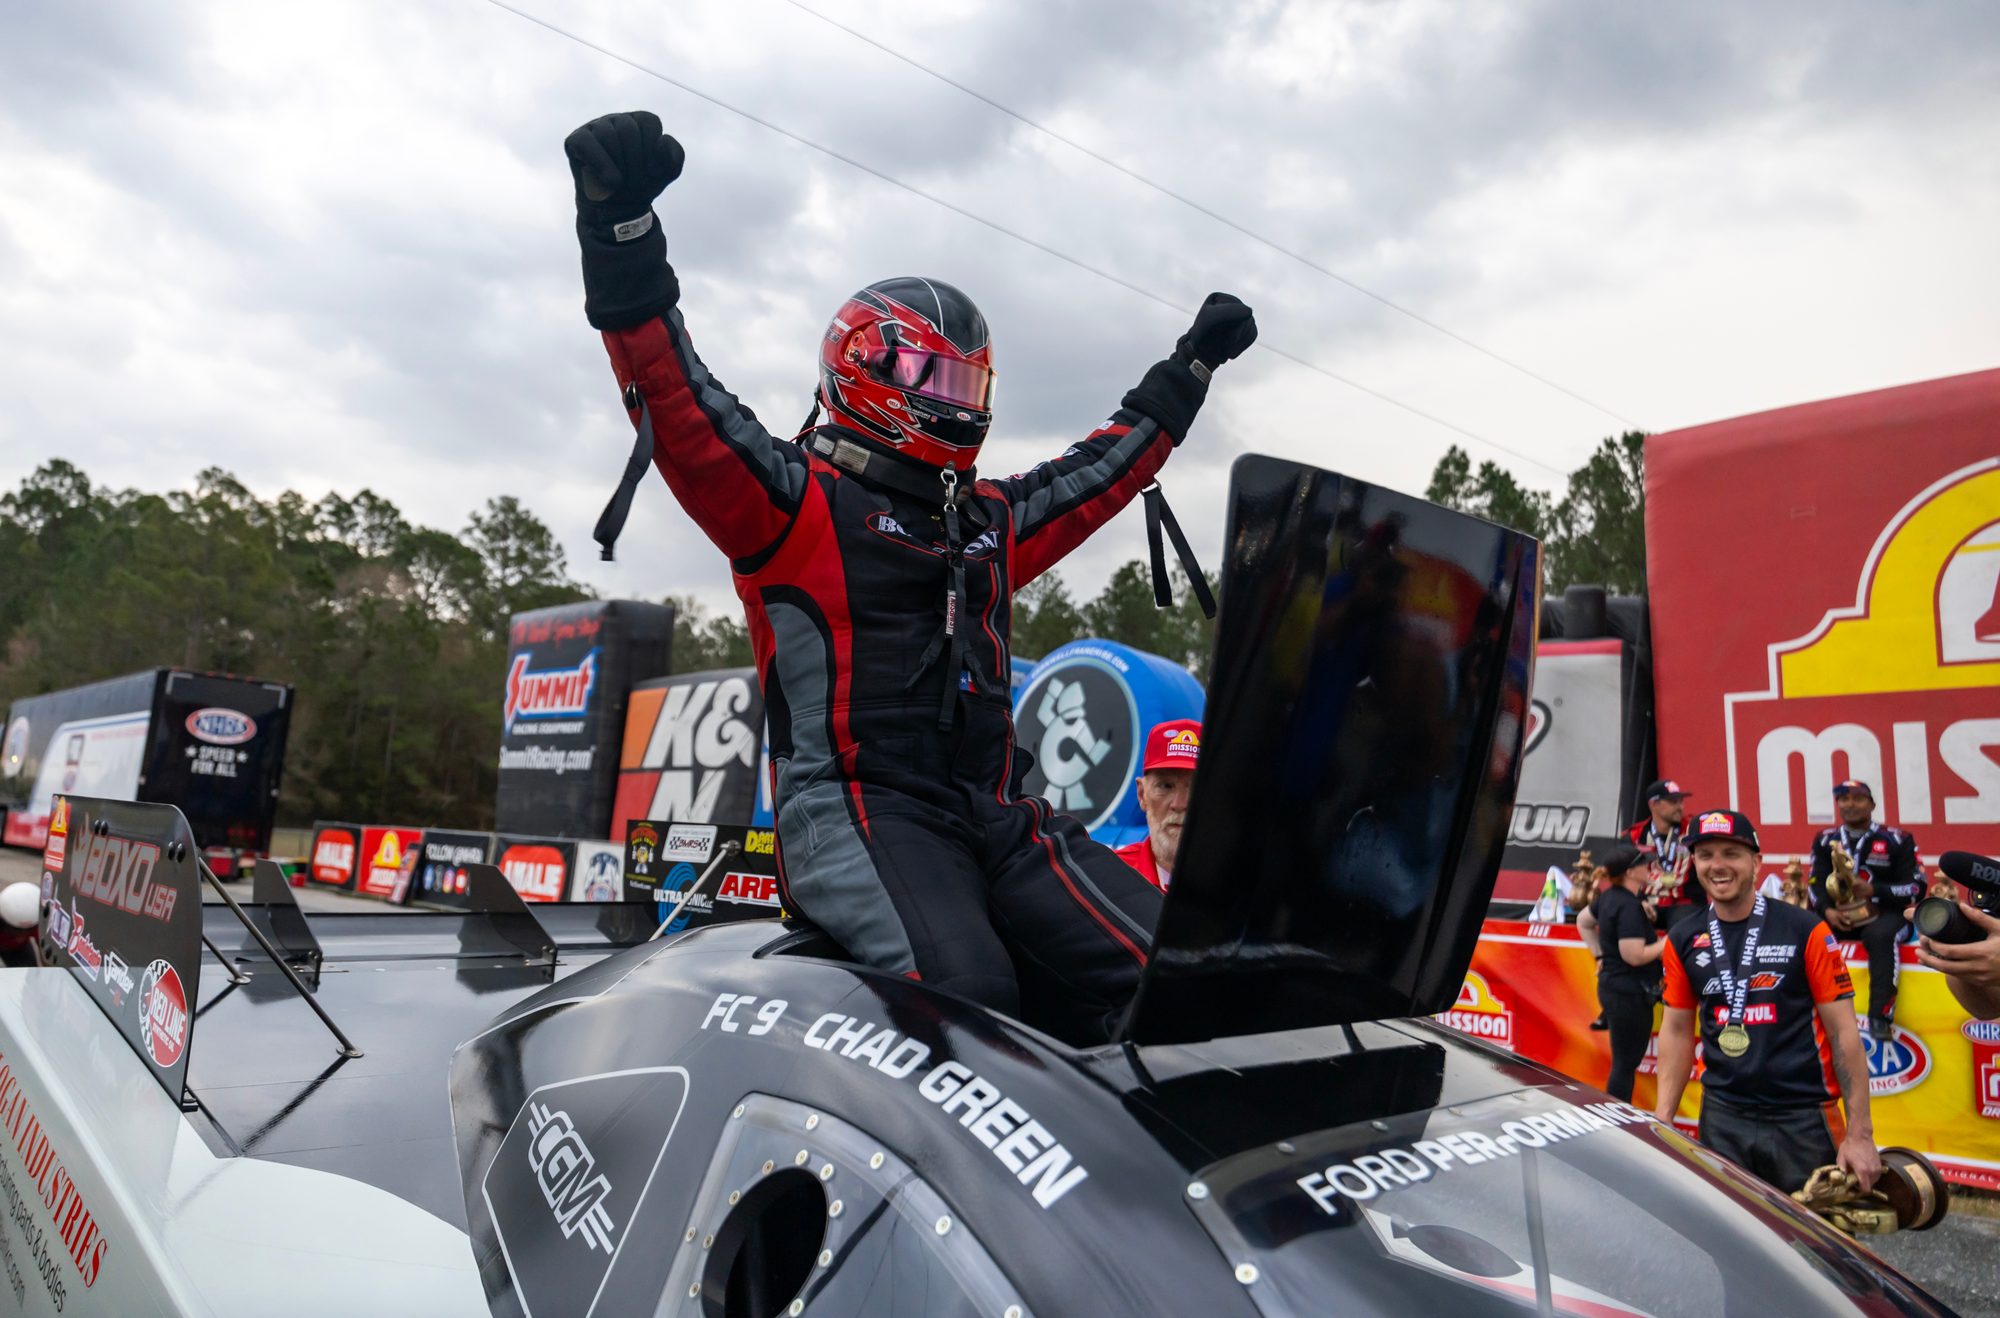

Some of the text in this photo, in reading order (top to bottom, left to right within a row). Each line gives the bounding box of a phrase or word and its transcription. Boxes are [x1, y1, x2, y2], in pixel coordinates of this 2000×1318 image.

[191, 758, 238, 777] FOR ALL
[199, 745, 236, 763] SPEED
[653, 887, 706, 907] ULTRASNIC
[720, 874, 778, 901] ARP
[1709, 919, 1726, 957] NHRA
[1742, 927, 1760, 966] NHRA
[150, 988, 187, 1047] RED LINE
[1718, 1007, 1774, 1022] MTUL
[1731, 979, 1749, 1019] NHRA
[700, 993, 1088, 1210] FC 9 CHAD GREEN
[1870, 1080, 1898, 1094] ING
[16, 1112, 108, 1289] INDUSTRIES
[1296, 1147, 1432, 1216] FORD
[15, 1201, 35, 1246] parts
[32, 1228, 43, 1259] &
[38, 1239, 67, 1314] bodies
